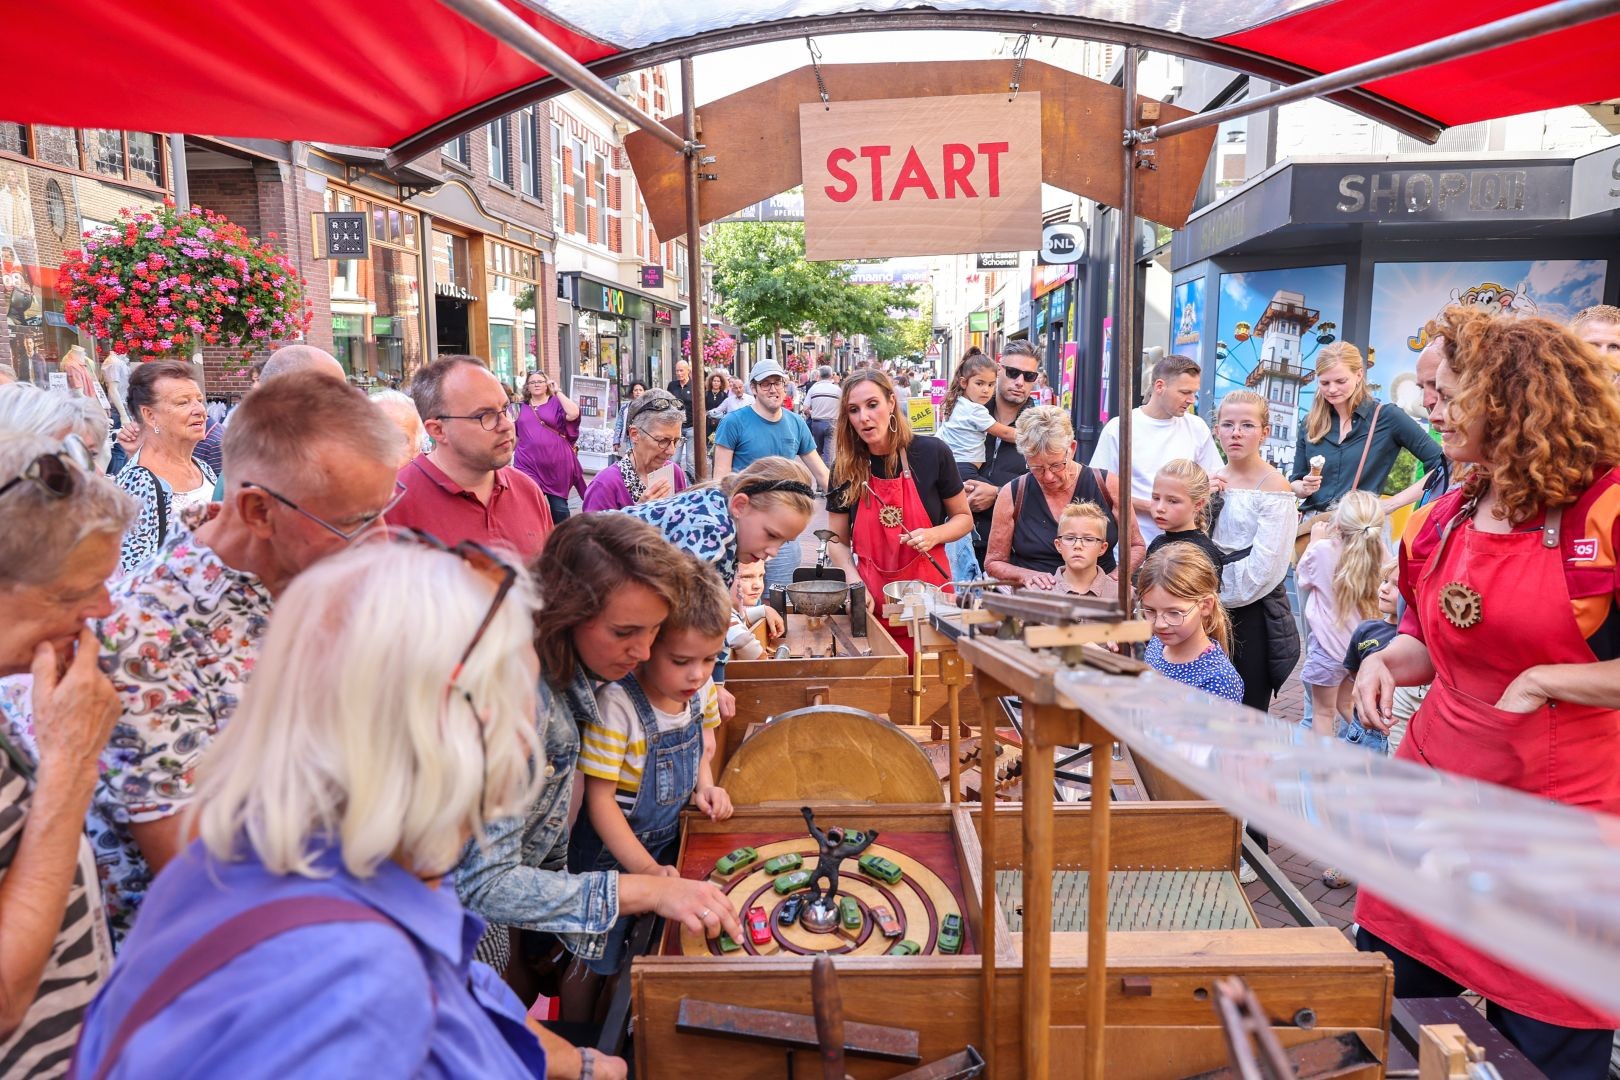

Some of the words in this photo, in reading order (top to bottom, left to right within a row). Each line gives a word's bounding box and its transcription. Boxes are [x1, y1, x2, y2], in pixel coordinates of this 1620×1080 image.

[824, 141, 1009, 203] START
[982, 258, 1018, 266] Schoenen
[849, 270, 894, 282] smaand
[602, 286, 624, 315] EXPO
[931, 386, 946, 394] 20%
[911, 407, 932, 423] SALE
